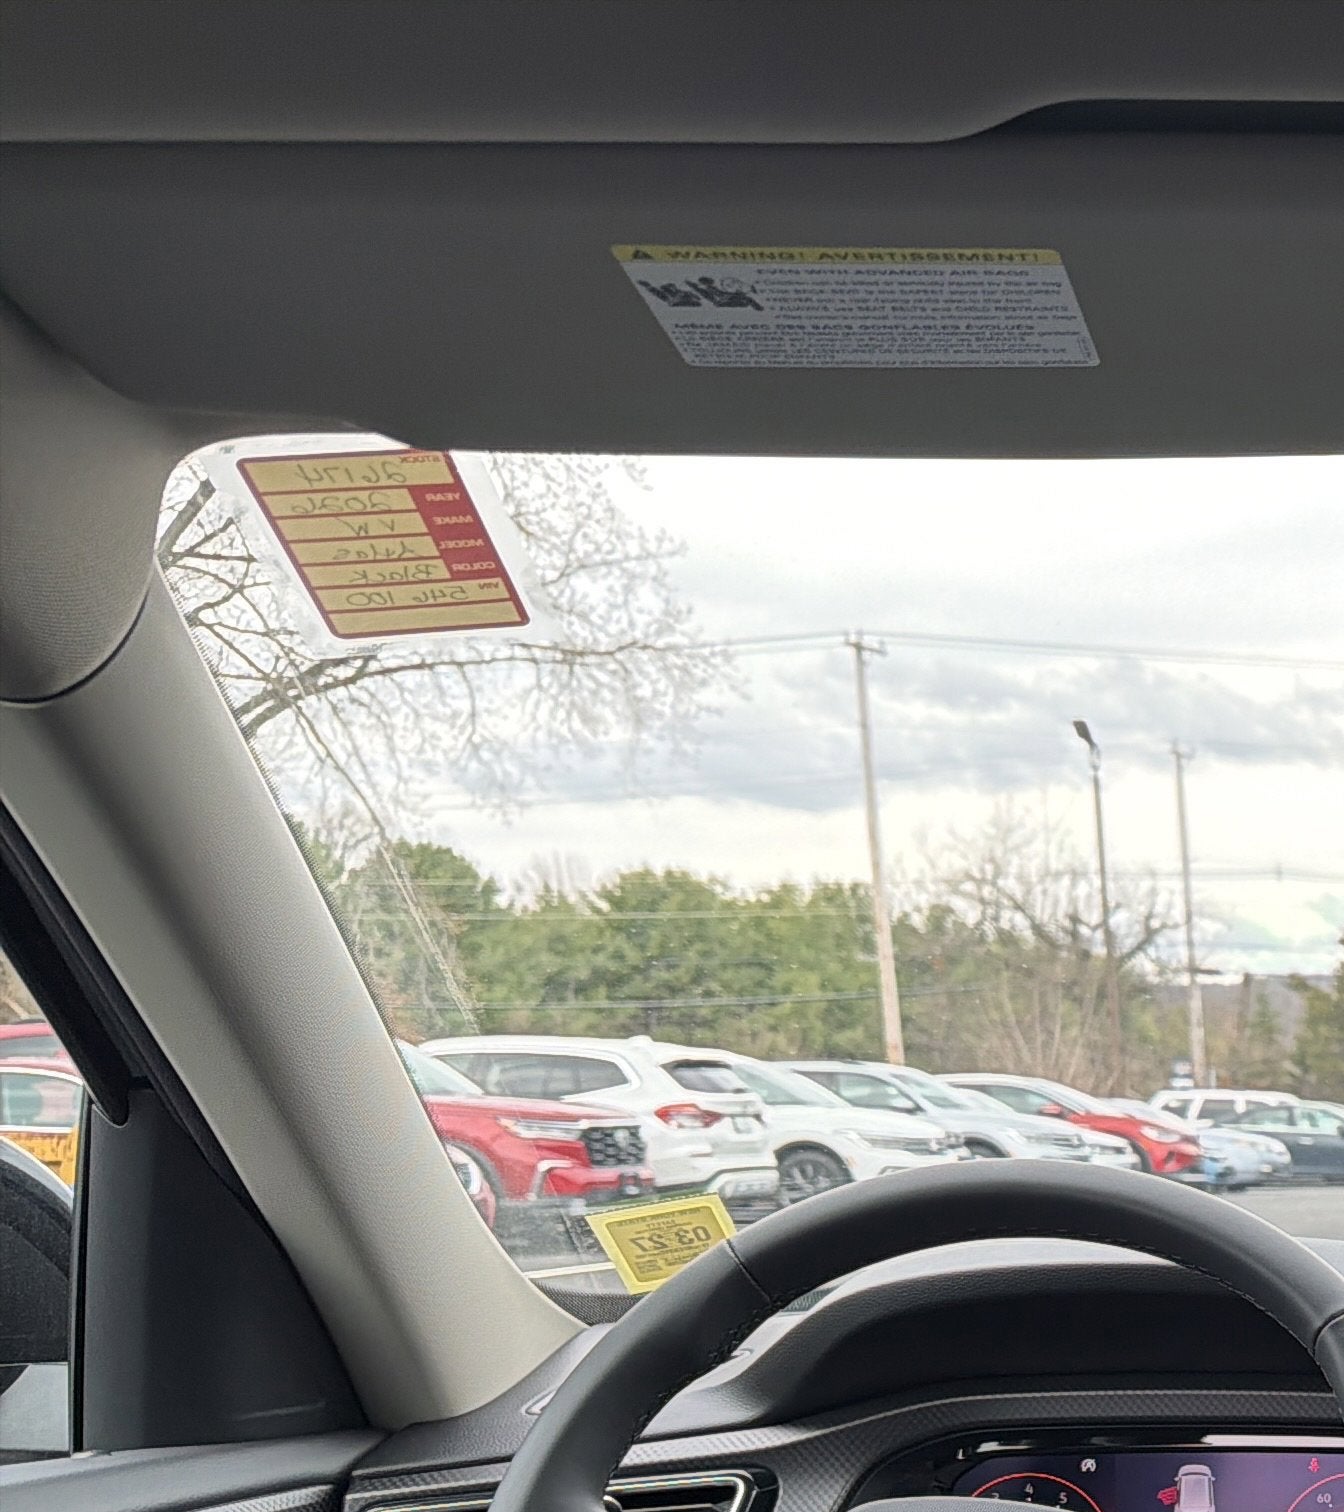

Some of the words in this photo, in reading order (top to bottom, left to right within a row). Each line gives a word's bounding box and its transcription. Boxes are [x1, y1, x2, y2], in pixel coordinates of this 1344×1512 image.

[1024, 1482, 1034, 1495] 4
[1059, 1491, 1068, 1504] 5
[1316, 1492, 1332, 1504] 60
